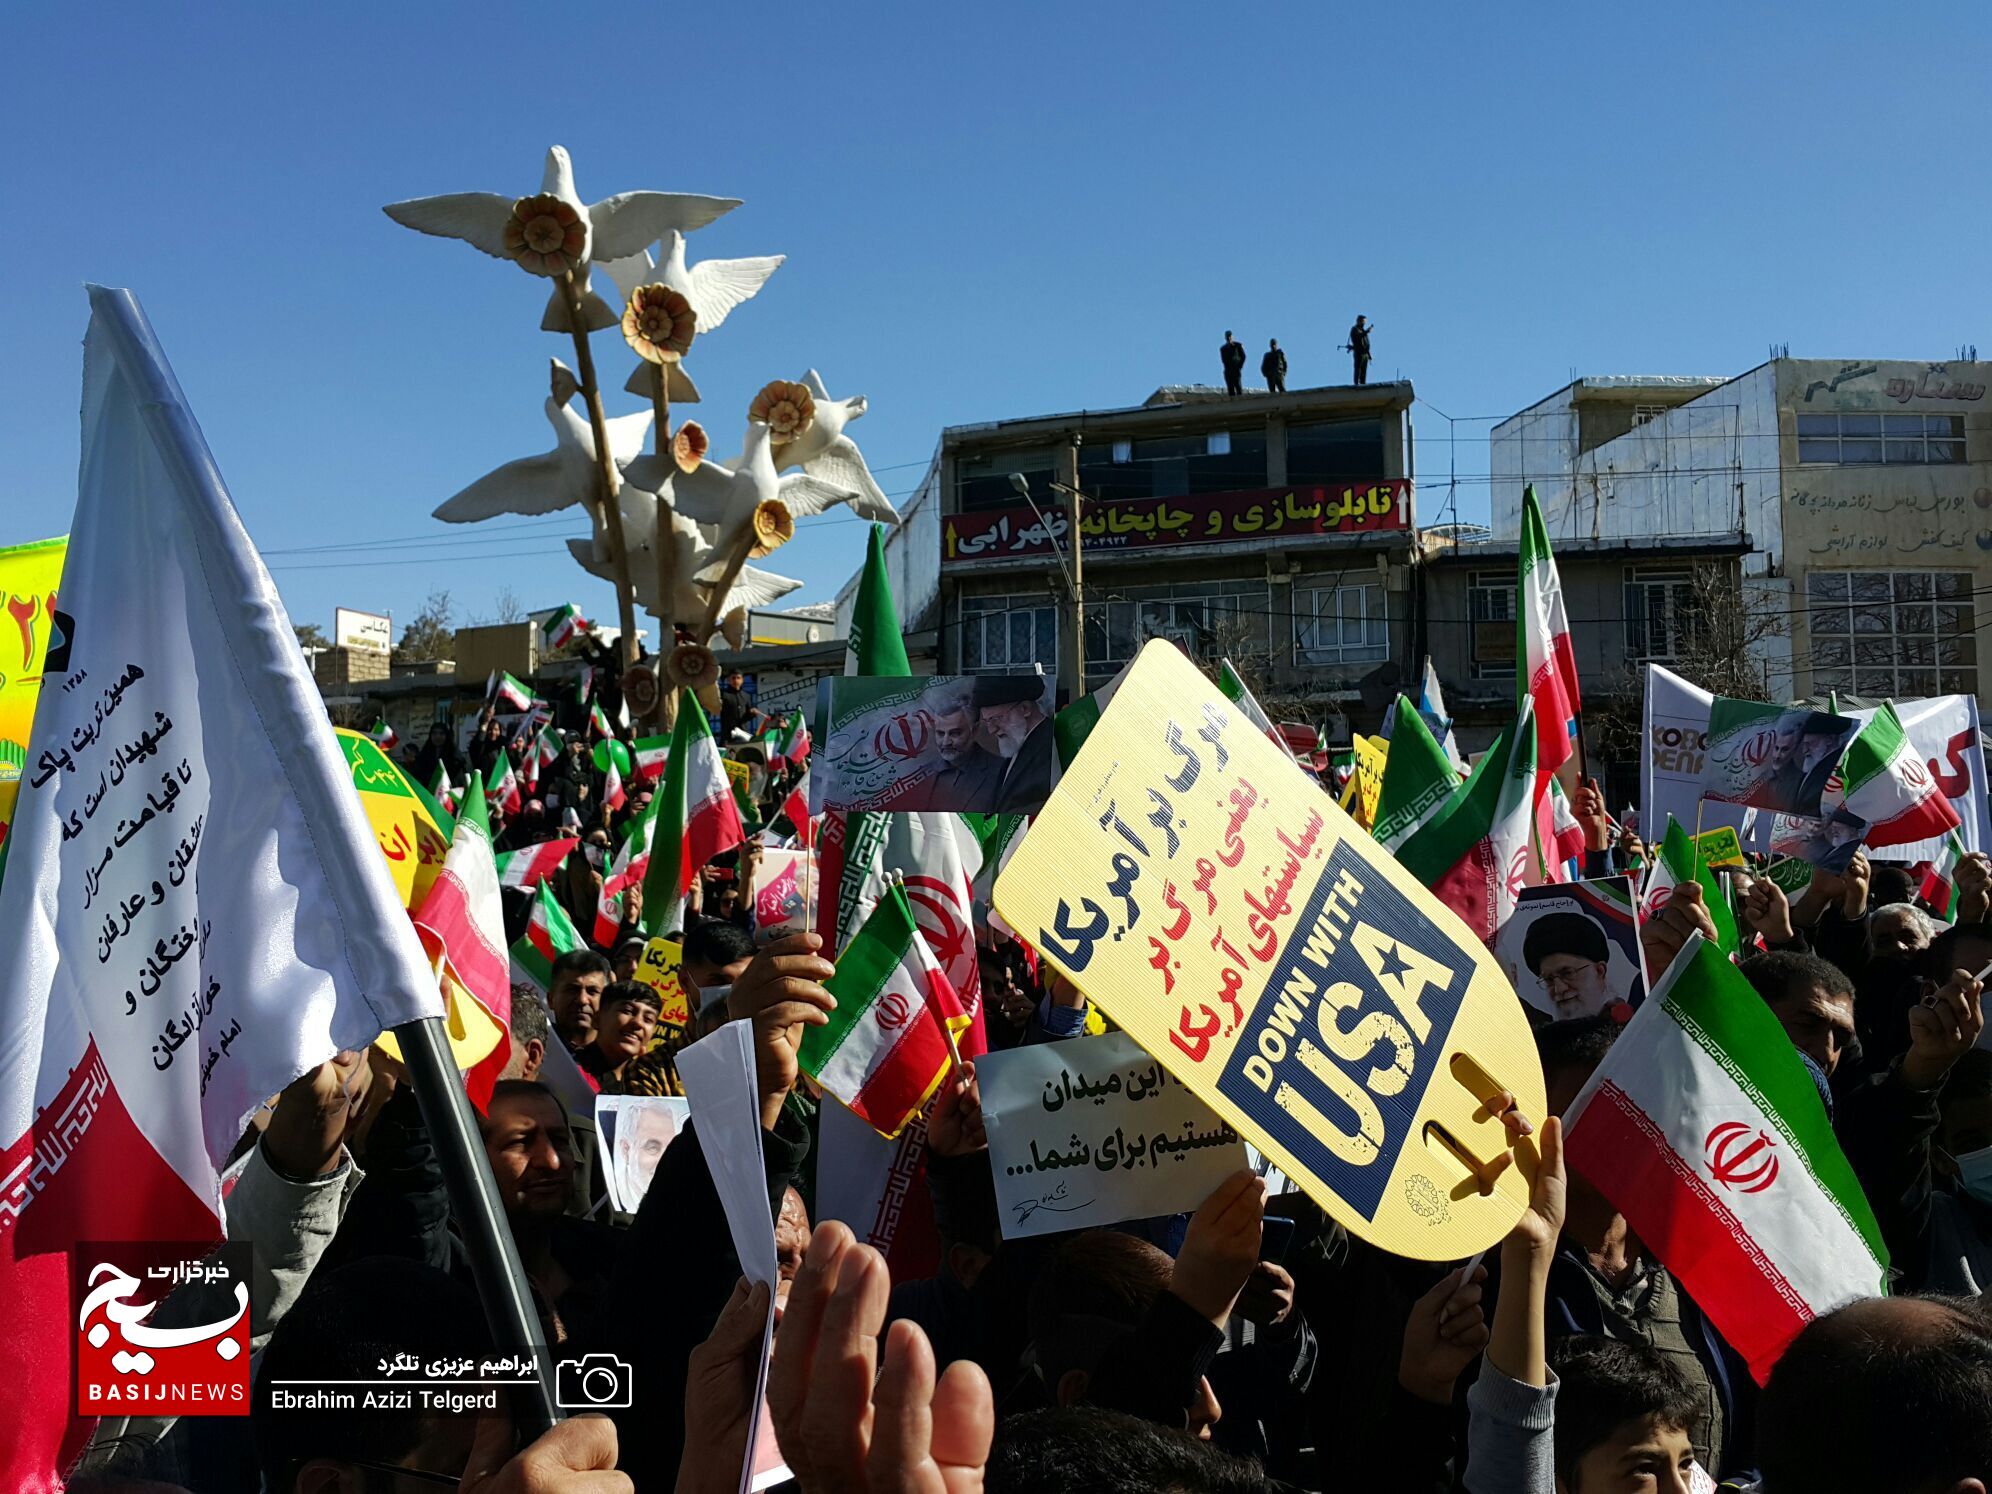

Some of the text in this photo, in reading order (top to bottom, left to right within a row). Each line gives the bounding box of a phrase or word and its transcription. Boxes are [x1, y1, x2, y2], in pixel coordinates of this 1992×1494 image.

[1079, 503, 1194, 541] چاپخانه
[1204, 510, 1223, 535] و
[31, 664, 145, 789] همین تربت پاک
[1163, 702, 1230, 794] مرگ
[62, 711, 173, 842] شهیدان است که
[84, 758, 192, 910] تا قیامت مزار
[380, 823, 449, 866] ایران
[1146, 787, 1188, 860] بر
[150, 881, 165, 906] و
[1039, 798, 1151, 973] آمریکا
[1147, 776, 1269, 996] یعنی مرگ بر
[98, 894, 146, 964] عارفان
[645, 948, 681, 975] مریکا
[1168, 806, 1325, 1063] سیاستهای آمریکا
[125, 990, 137, 1016] و
[1242, 867, 1366, 1094] DOWN WITH
[219, 1018, 242, 1058] امام
[1273, 920, 1455, 1167] USA
[1042, 1069, 1122, 1112] میدان
[1126, 1061, 1166, 1101] این
[1006, 1120, 1239, 1177] هستیم برای شما...
